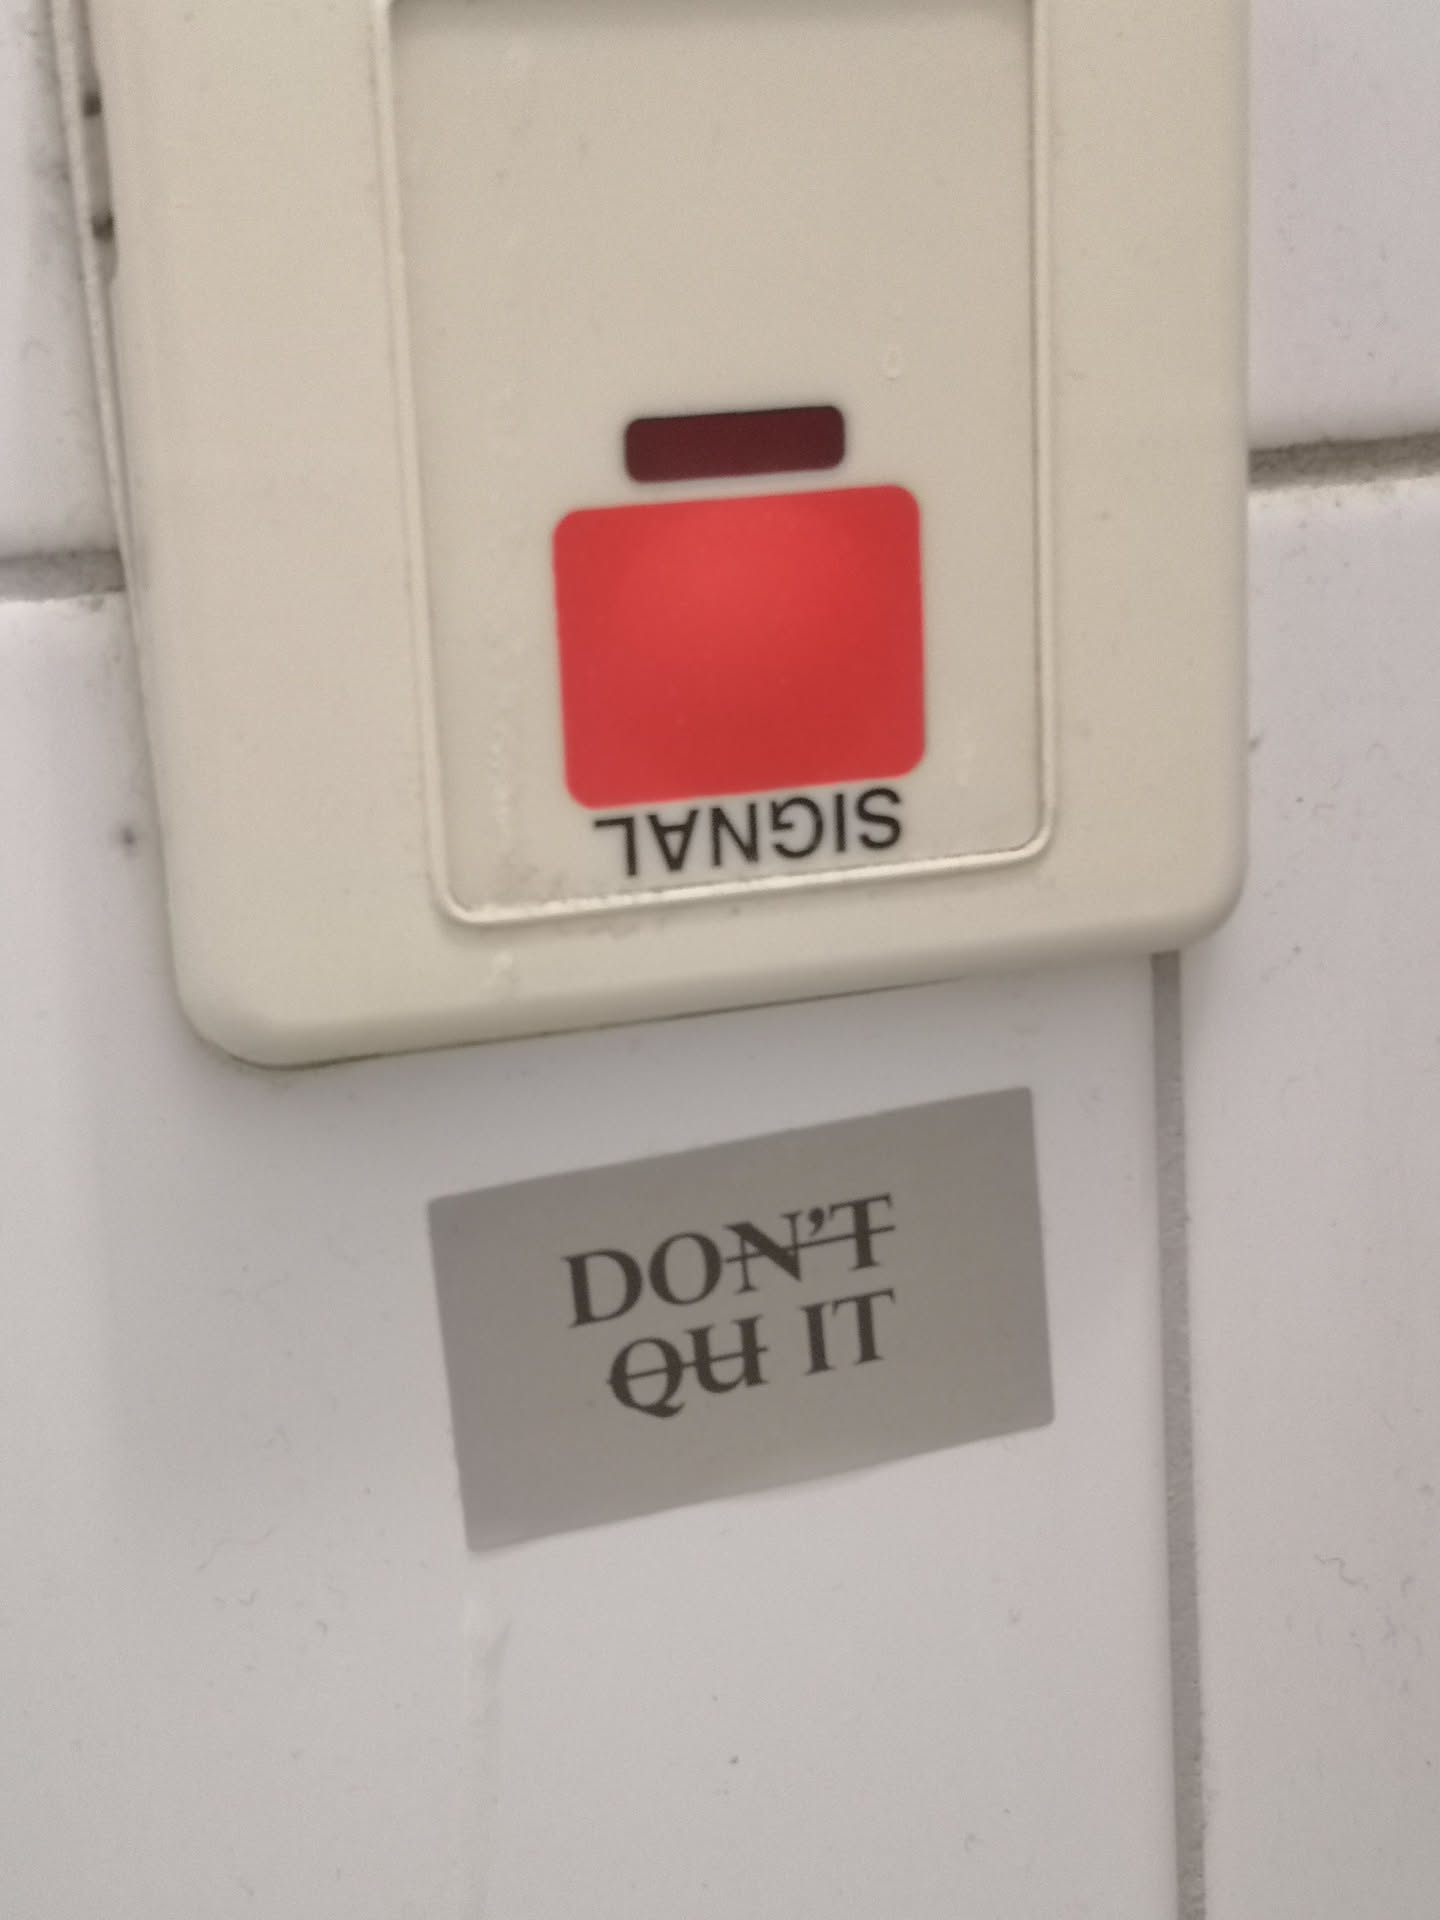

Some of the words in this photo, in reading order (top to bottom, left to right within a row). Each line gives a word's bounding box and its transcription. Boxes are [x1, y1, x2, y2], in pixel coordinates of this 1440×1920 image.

[594, 788, 902, 877] SIGNAL
[562, 1193, 896, 1328] DON'T
[606, 1315, 769, 1419] QU
[800, 1288, 896, 1375] IT
